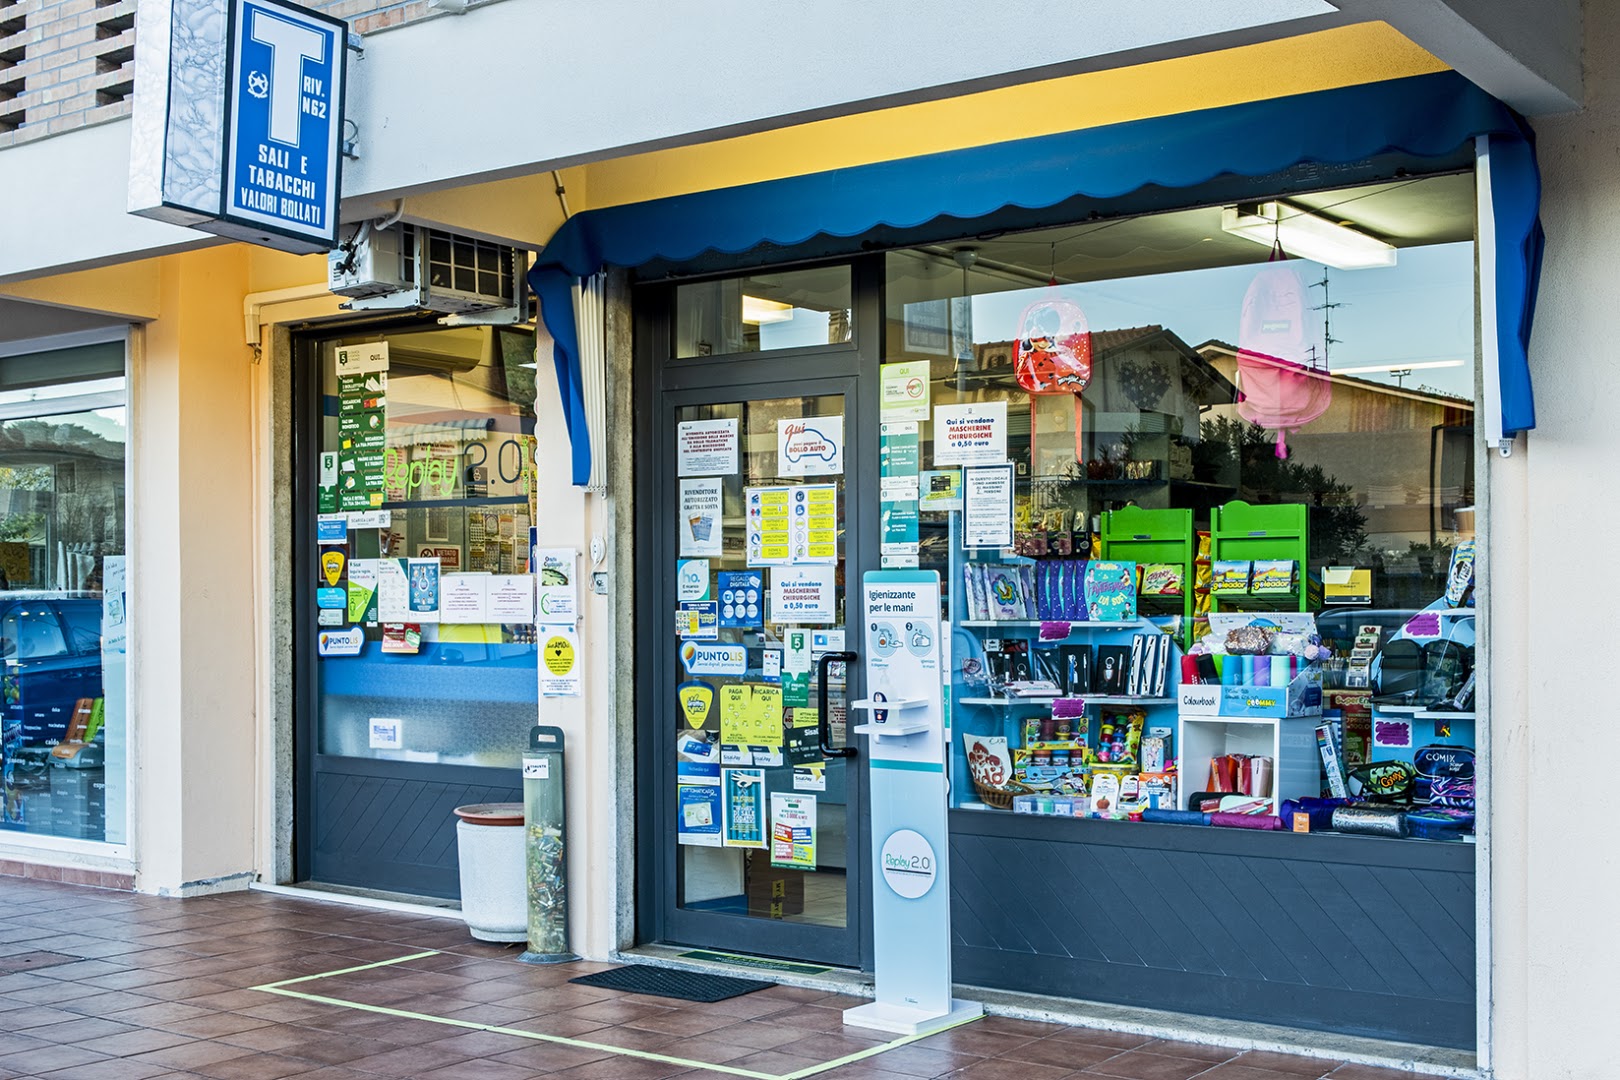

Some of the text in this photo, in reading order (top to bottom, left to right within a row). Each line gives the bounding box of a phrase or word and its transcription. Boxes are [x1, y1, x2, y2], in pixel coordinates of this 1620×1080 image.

[251, 8, 326, 149] T
[303, 75, 325, 97] RIV.
[303, 96, 326, 119] N62
[258, 144, 307, 175] SALI E
[249, 164, 315, 200] TABACCHI
[241, 187, 320, 225] VALORI BOLLATI
[464, 440, 522, 484] 2.0
[382, 444, 458, 499] Replay
[1128, 584, 1134, 596] 2
[1212, 581, 1246, 590] goleador
[1254, 580, 1288, 590] goleador
[868, 590, 916, 601] Igienizzante
[870, 602, 914, 614] per le mani
[794, 638, 801, 648] 5
[698, 652, 743, 661] PUNTOLIS
[1183, 695, 1216, 706] Colourbook
[1335, 696, 1371, 705] SuperEn
[1426, 752, 1456, 762] COMIX
[886, 853, 930, 870] Replay 2.0
